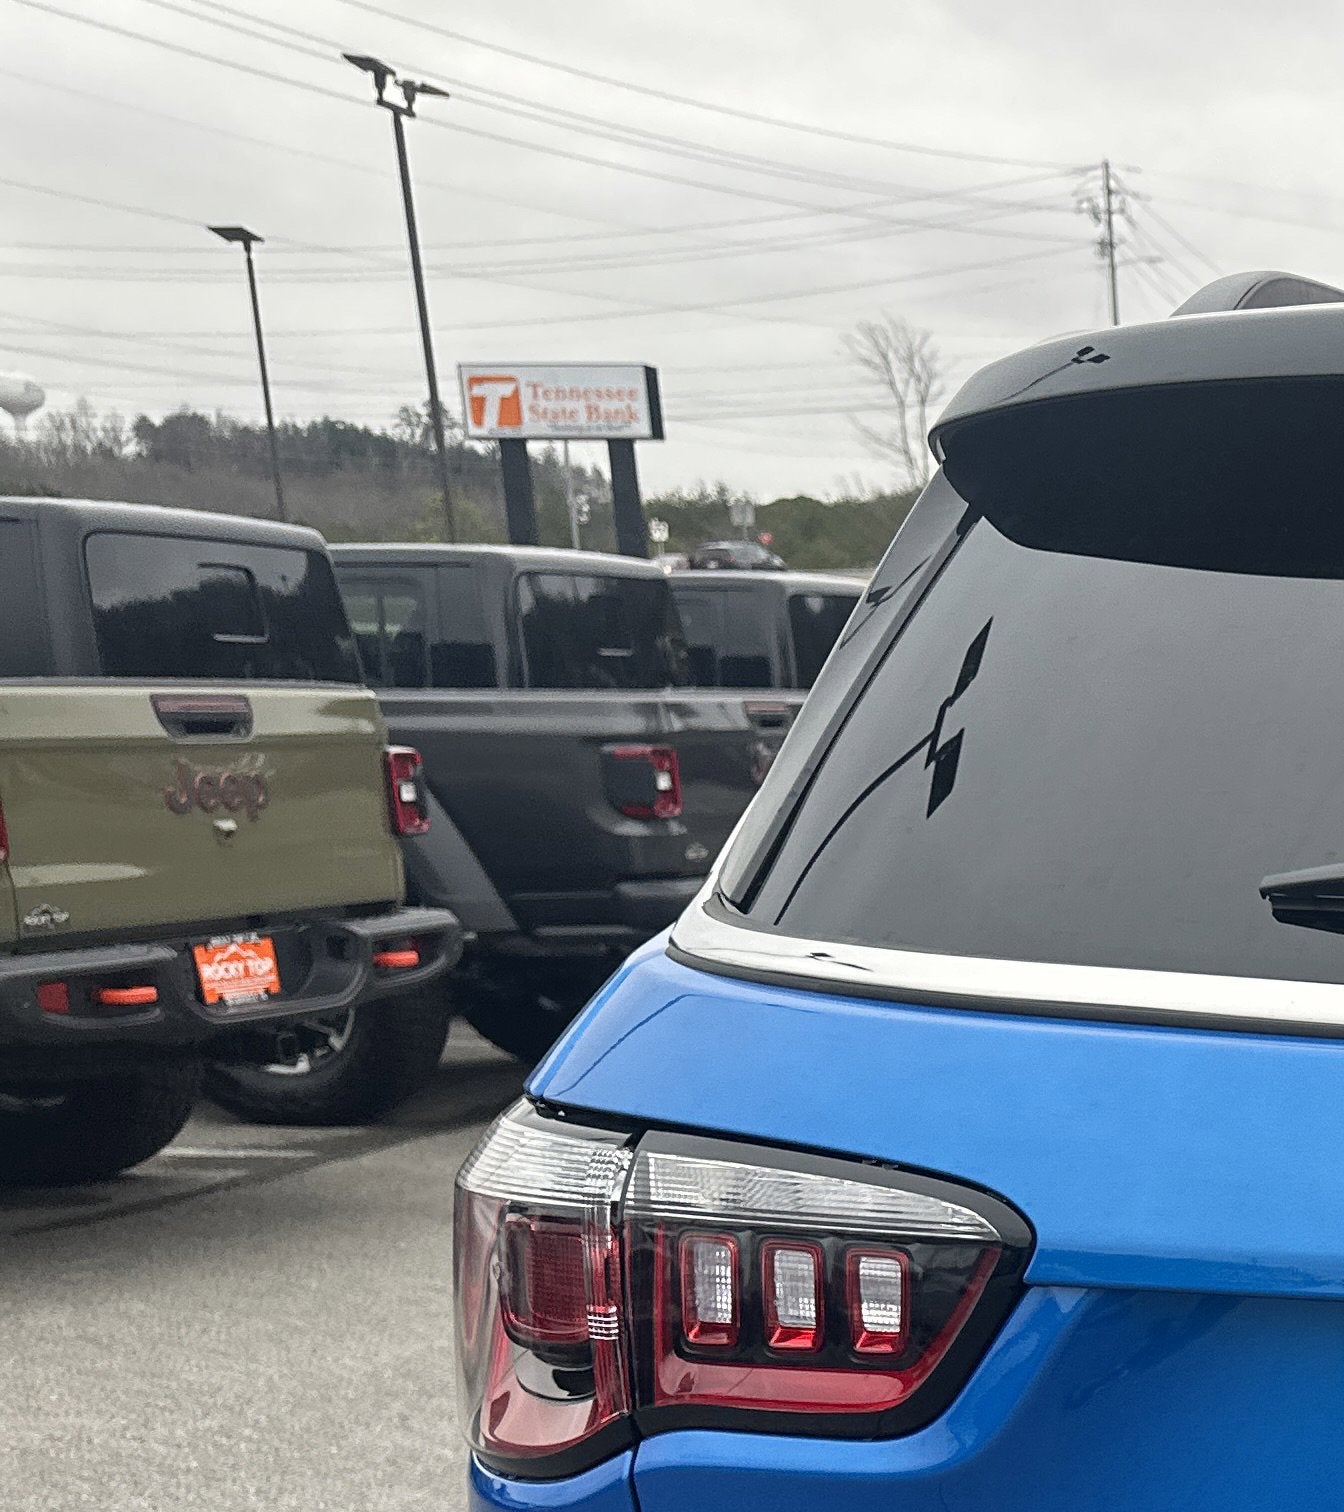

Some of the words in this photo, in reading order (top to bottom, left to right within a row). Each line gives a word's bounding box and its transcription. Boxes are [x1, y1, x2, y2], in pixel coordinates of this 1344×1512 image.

[527, 381, 639, 401] Tennessee
[527, 403, 578, 422] State
[584, 402, 641, 423] Bank
[164, 759, 269, 821] Jeep
